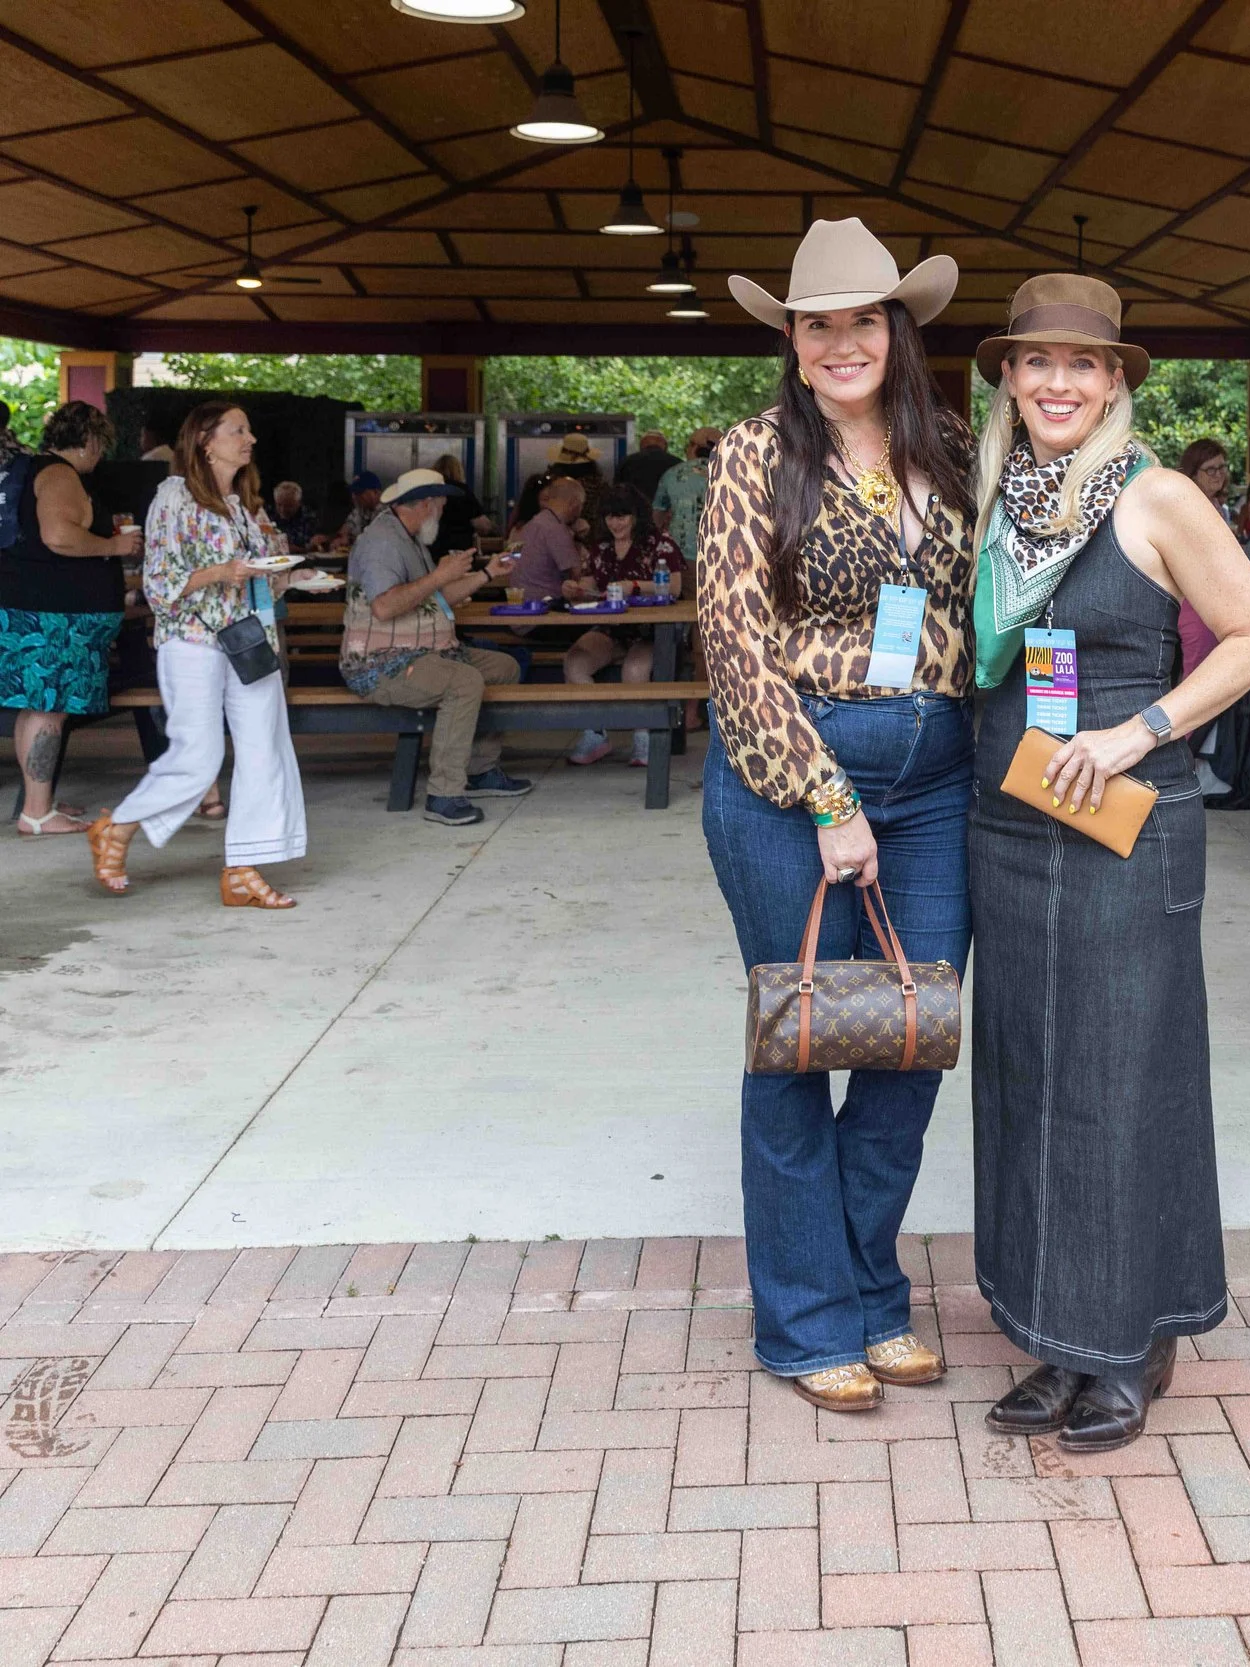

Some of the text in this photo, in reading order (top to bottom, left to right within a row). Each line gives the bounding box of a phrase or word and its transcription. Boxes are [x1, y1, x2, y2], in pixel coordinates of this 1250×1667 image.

[1055, 651, 1073, 665] ZOO
[1055, 664, 1075, 676] LA LA
